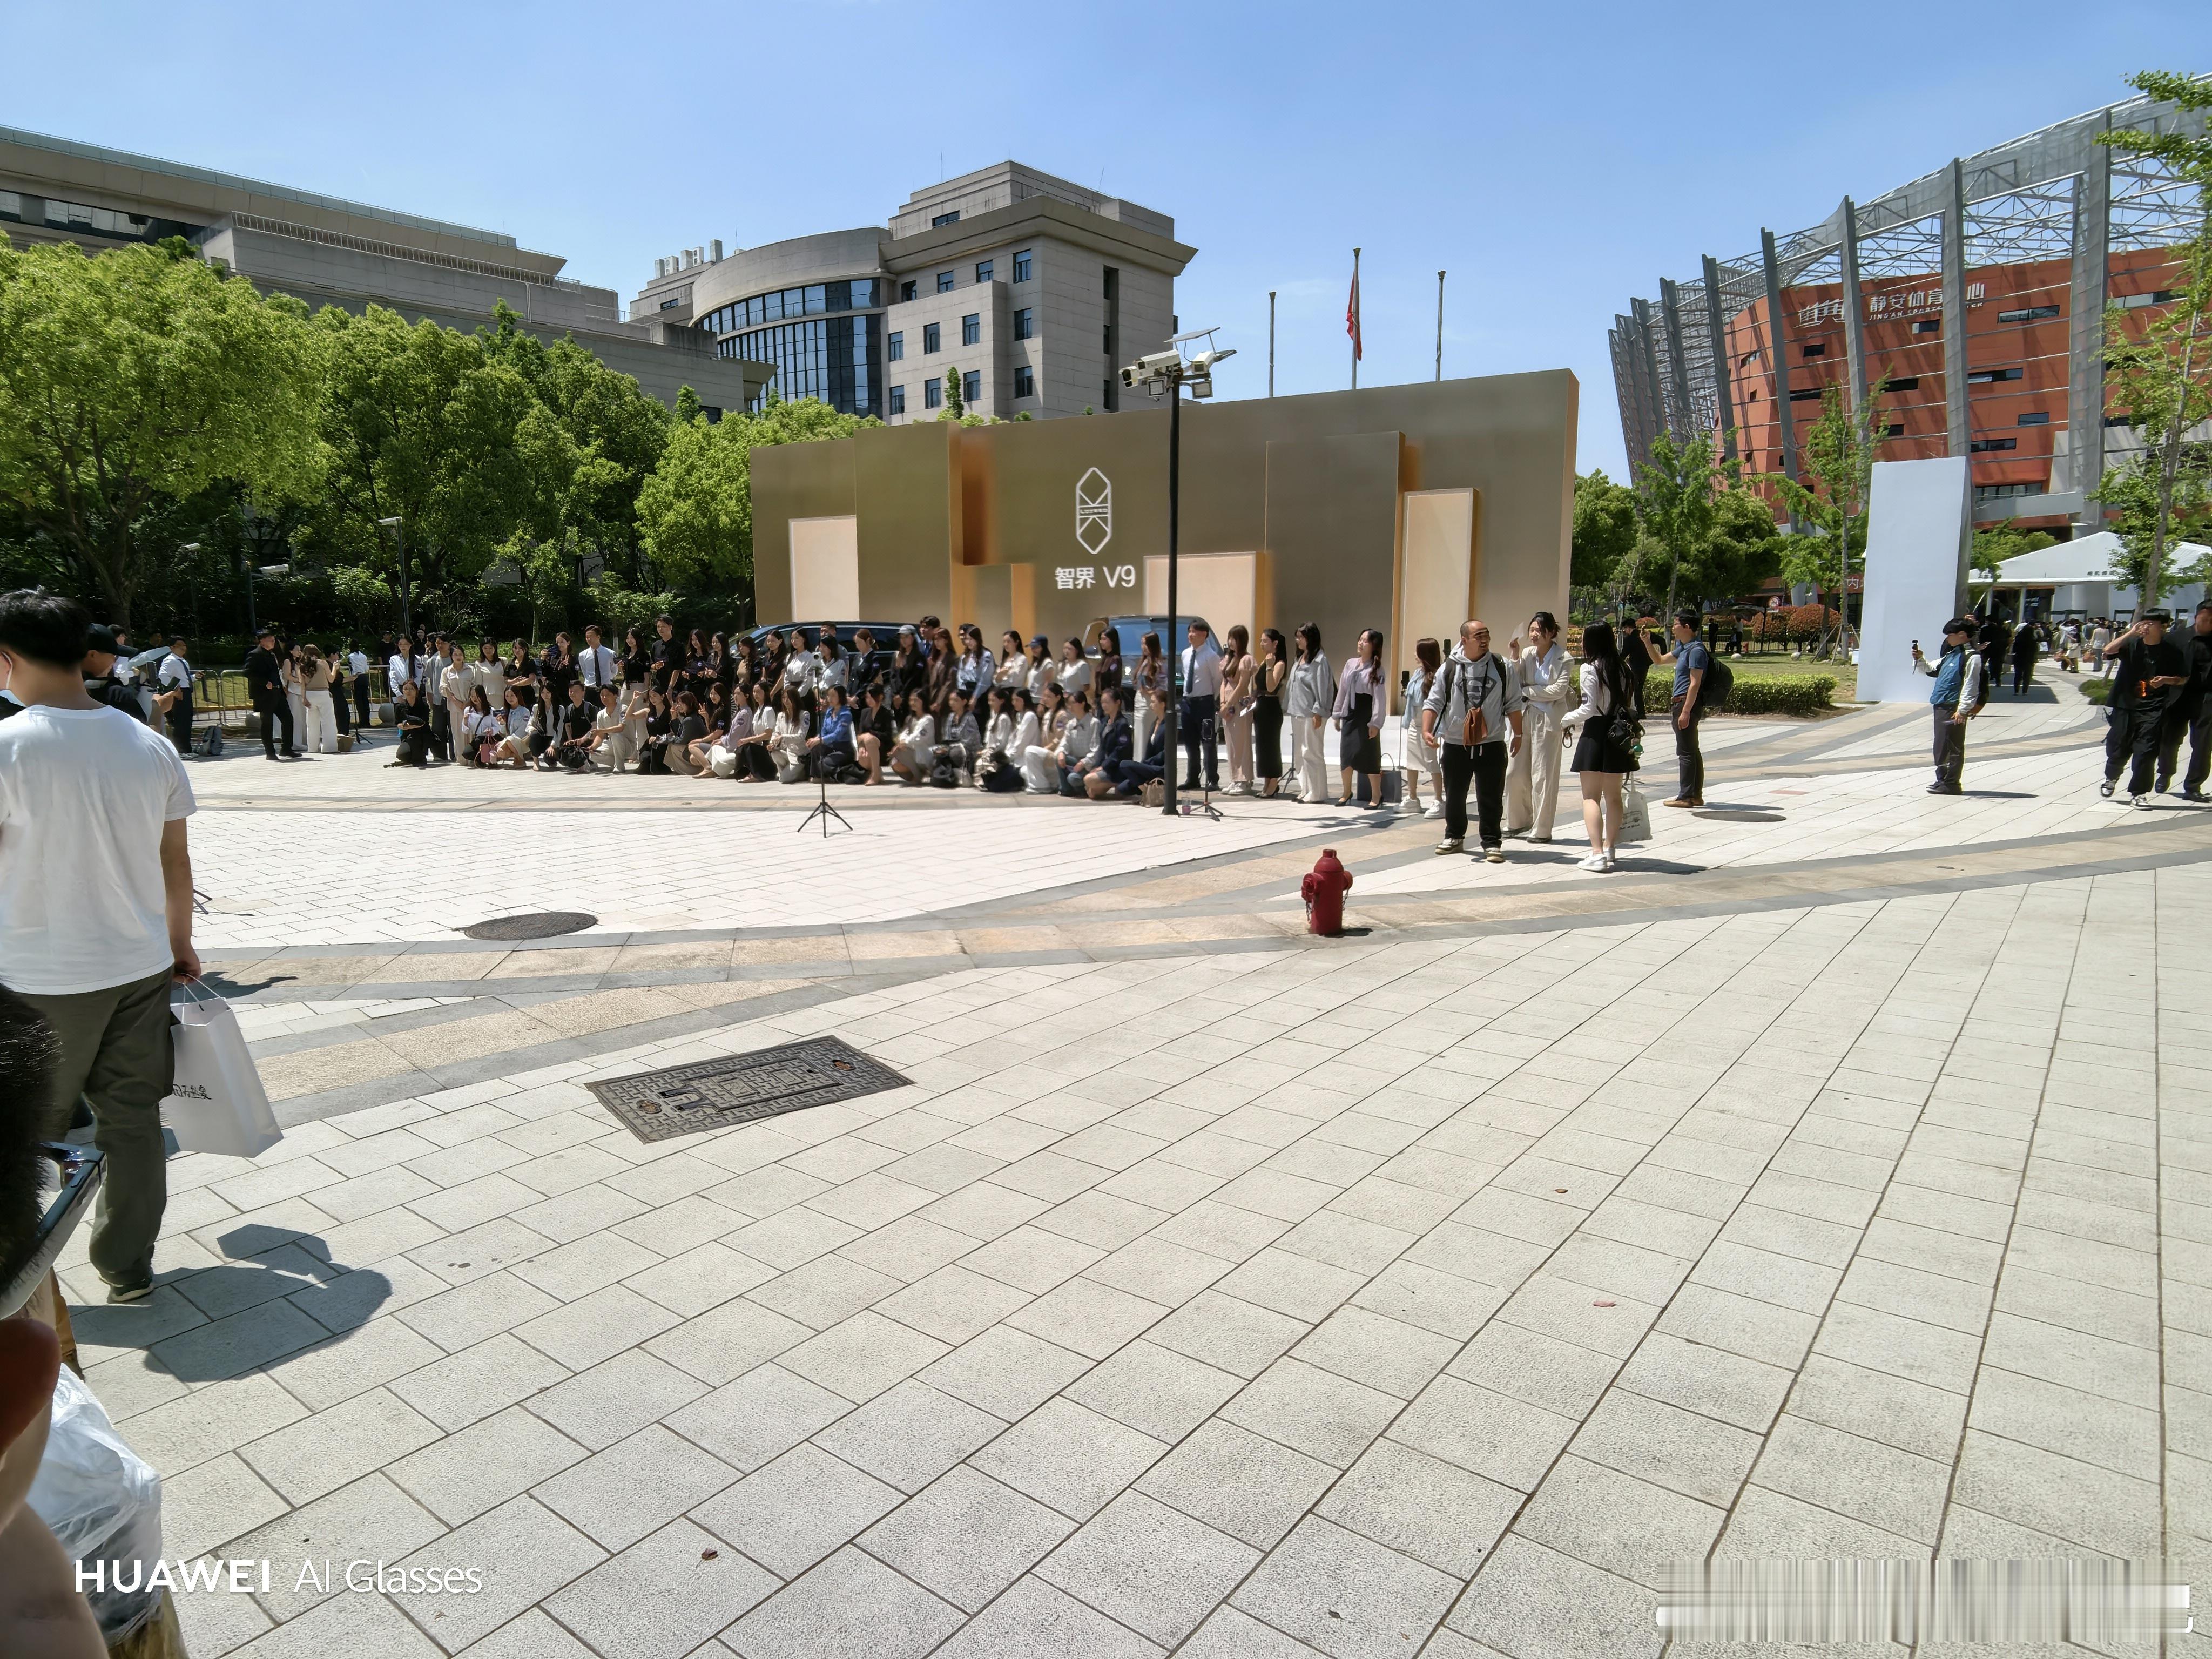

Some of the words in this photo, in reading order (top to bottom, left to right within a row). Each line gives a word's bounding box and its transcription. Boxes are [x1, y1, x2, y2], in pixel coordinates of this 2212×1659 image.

[1870, 282, 1985, 312] 静安体育心
[1055, 567, 1096, 589] 智界
[1103, 565, 1136, 588] V9
